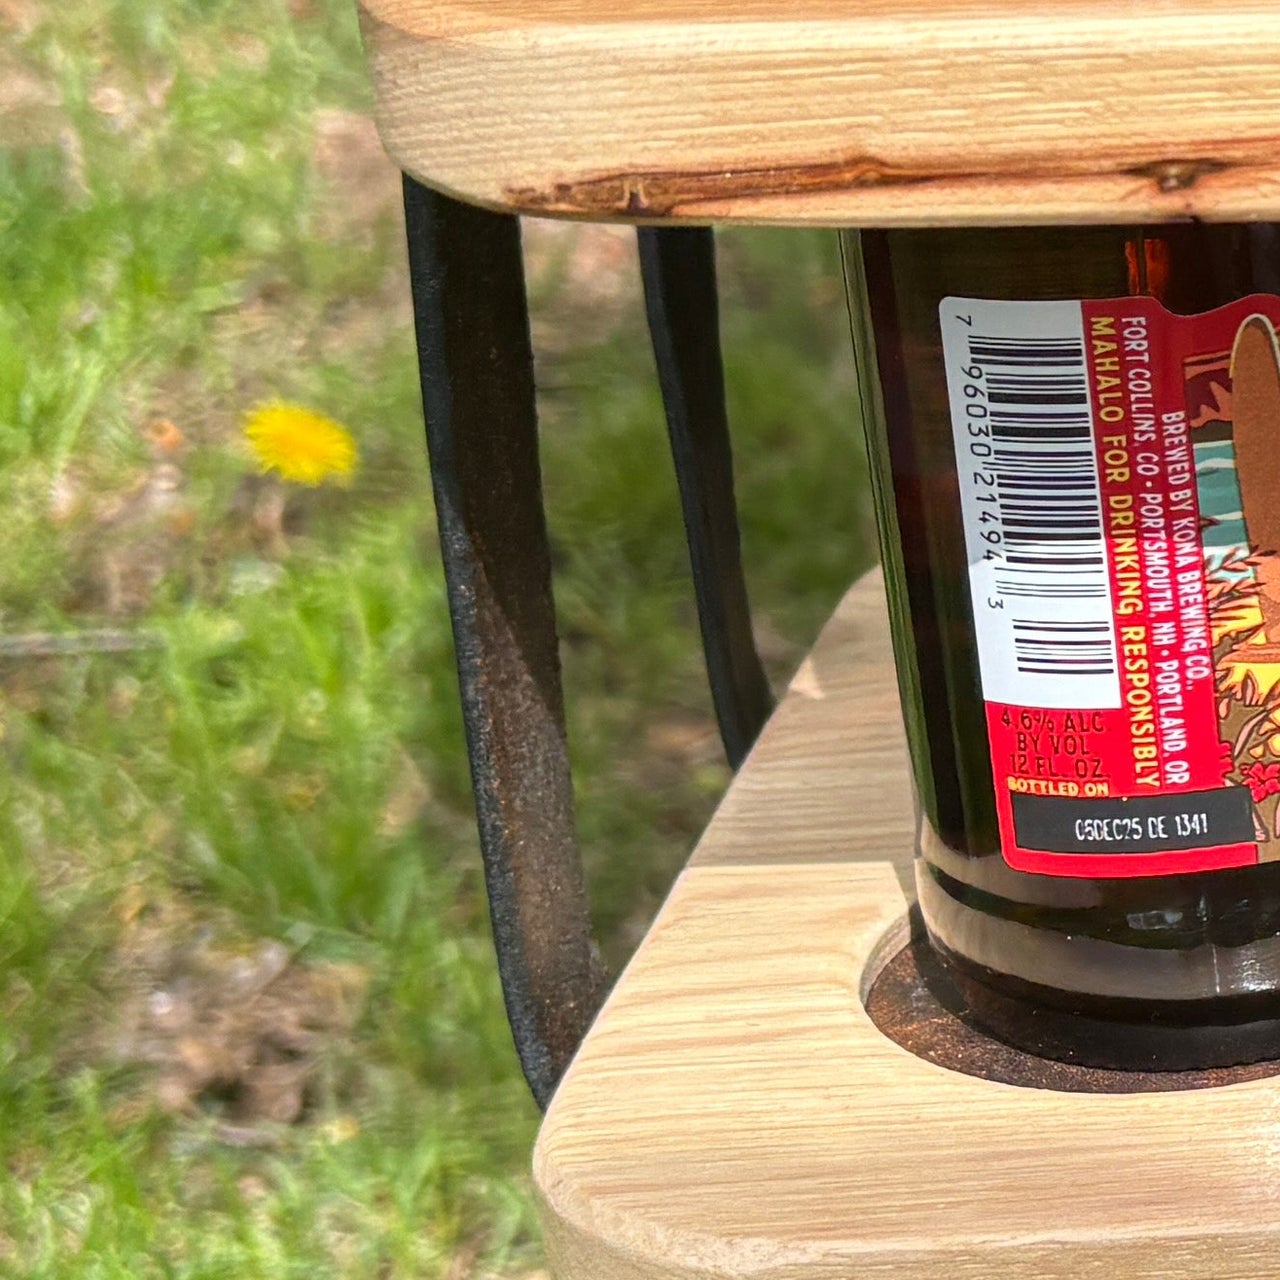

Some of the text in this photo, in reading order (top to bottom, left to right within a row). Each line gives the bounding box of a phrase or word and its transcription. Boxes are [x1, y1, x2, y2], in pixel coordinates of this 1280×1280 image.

[955, 314, 973, 327] 7
[1161, 410, 1191, 485] BREWED
[961, 365, 1003, 562] 96030 21494
[1169, 490, 1194, 512] BY
[1091, 316, 1160, 787] MAHALO FOR DRINKING RESPONSIBLY
[1122, 316, 1149, 363] FORT
[1136, 453, 1159, 476] CO
[1152, 621, 1176, 646] NH
[1164, 760, 1190, 784] OR
[1172, 516, 1199, 568] KONA
[987, 596, 1004, 609] 3
[1177, 570, 1208, 653] BREWING
[1001, 707, 1055, 732] 4.6%
[1017, 732, 1040, 753] BY
[1010, 754, 1030, 774] 12
[1007, 776, 1110, 797] BOTTLED ON
